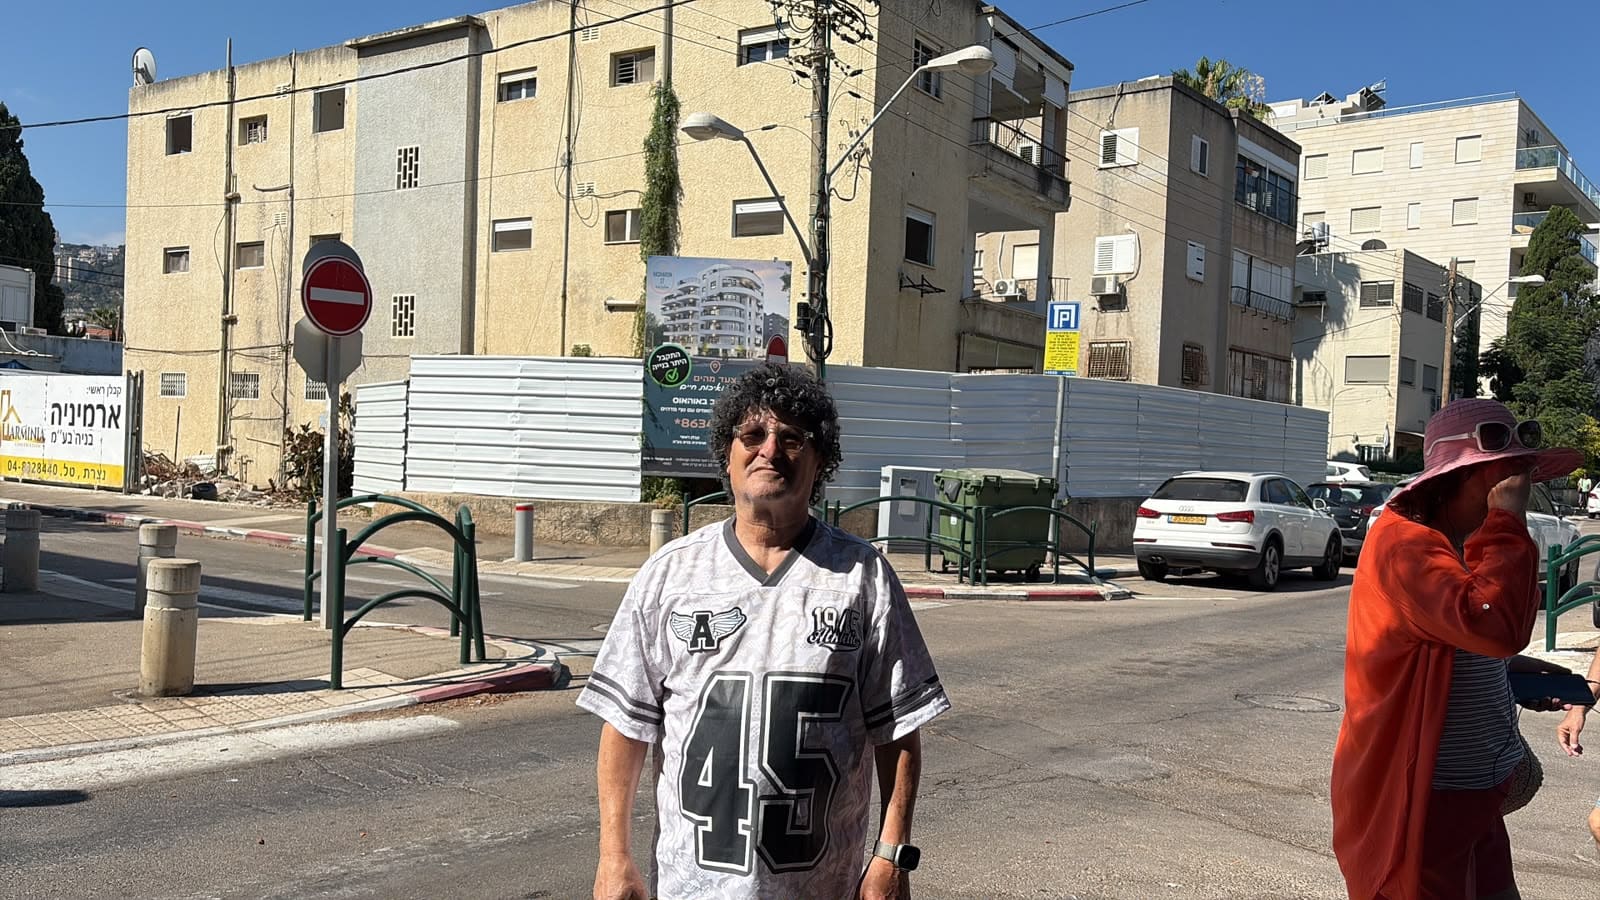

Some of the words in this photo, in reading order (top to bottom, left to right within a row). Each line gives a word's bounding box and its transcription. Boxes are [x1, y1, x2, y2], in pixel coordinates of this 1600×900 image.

[656, 351, 681, 361] התקבל
[670, 358, 688, 367] היתר
[652, 361, 669, 371] בנייה
[86, 386, 105, 395] ראשי:
[107, 384, 122, 398] קבלן
[51, 402, 122, 429] ארמיניה
[75, 432, 94, 446] בניה
[690, 612, 715, 649] A
[677, 670, 855, 876] 45
